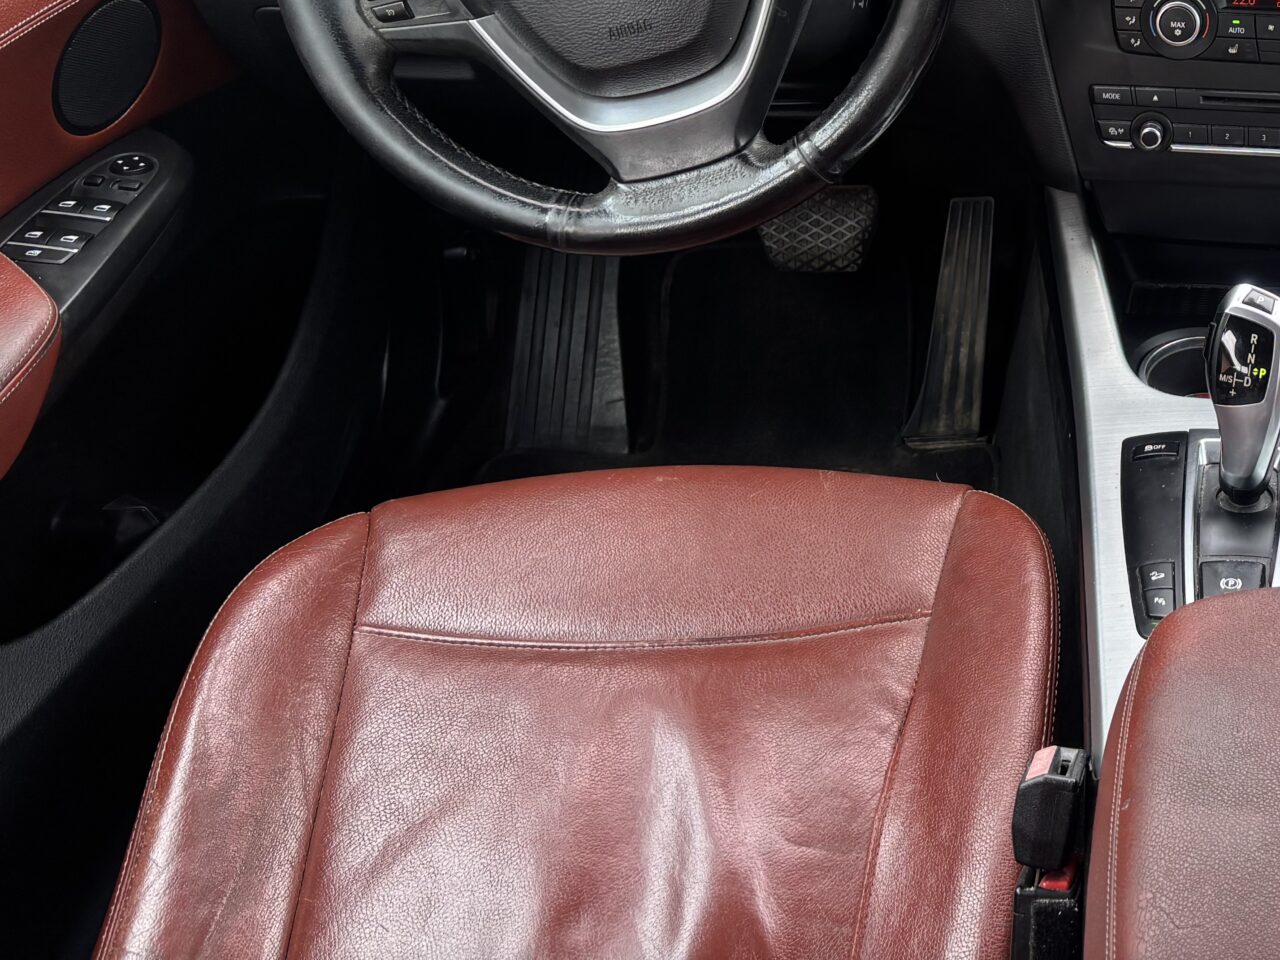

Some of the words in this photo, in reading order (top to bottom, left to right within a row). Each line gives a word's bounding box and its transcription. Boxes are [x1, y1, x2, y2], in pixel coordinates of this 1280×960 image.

[1170, 21, 1186, 29] MAX
[1102, 92, 1121, 100] MODE
[1256, 296, 1264, 304] P
[1250, 334, 1258, 344] R
[1247, 352, 1256, 364] N
[1259, 368, 1266, 378] P
[1219, 374, 1233, 383] M/S
[1243, 376, 1252, 387] D
